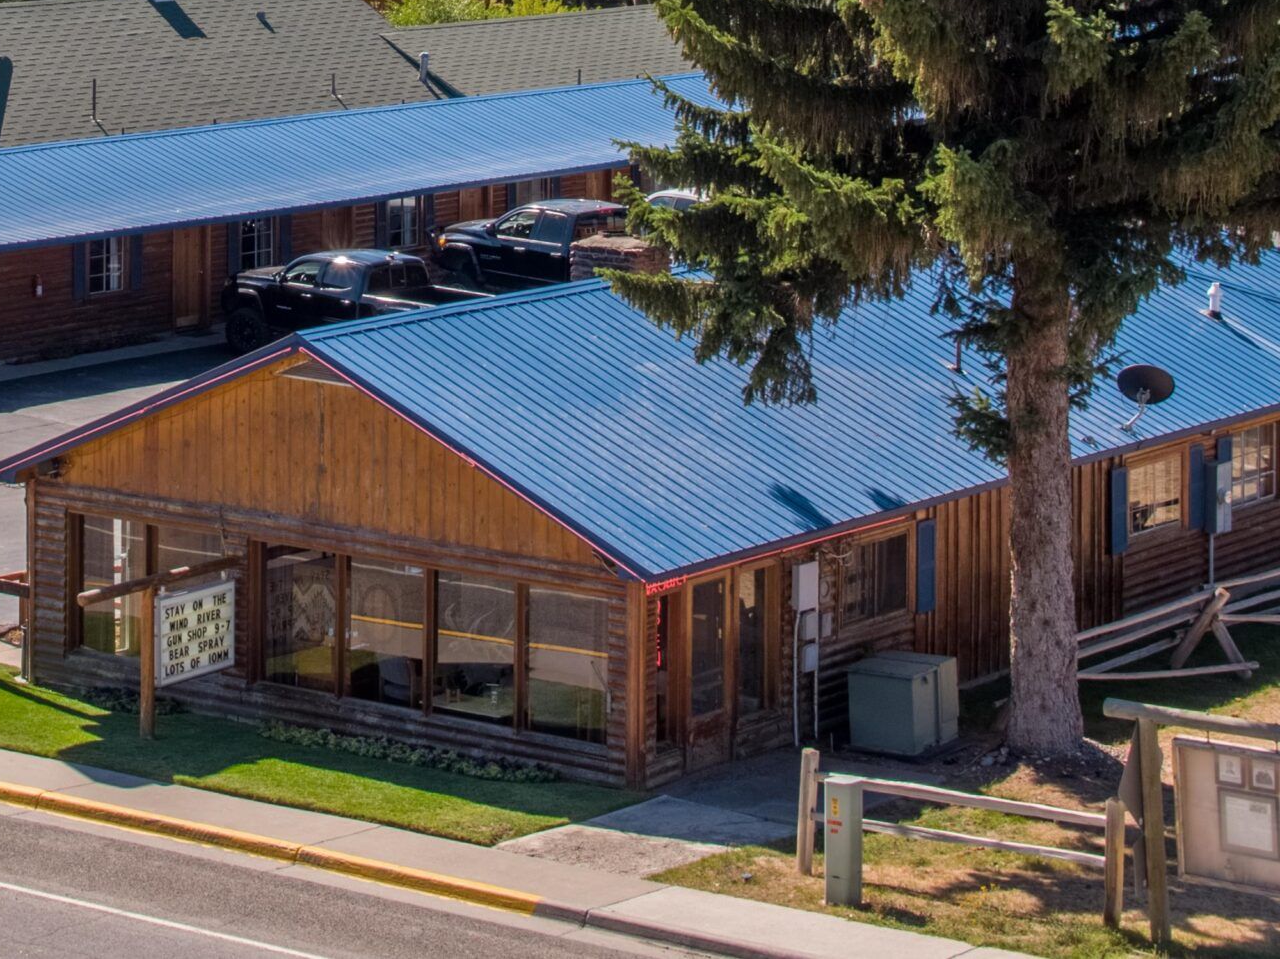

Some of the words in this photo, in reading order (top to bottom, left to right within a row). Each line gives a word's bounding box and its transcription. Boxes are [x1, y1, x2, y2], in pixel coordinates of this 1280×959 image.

[165, 604, 185, 620] STAY
[192, 599, 204, 611] ON
[212, 593, 227, 606] THE
[169, 617, 189, 632] WIND
[197, 609, 221, 624] RIVER
[167, 634, 182, 647] GUN
[187, 626, 207, 642] SHOP
[214, 620, 231, 634] 9-7
[169, 646, 189, 660] BEAR
[198, 635, 225, 653] SPRAY
[165, 662, 185, 676] LOTS
[190, 657, 201, 669] OF
